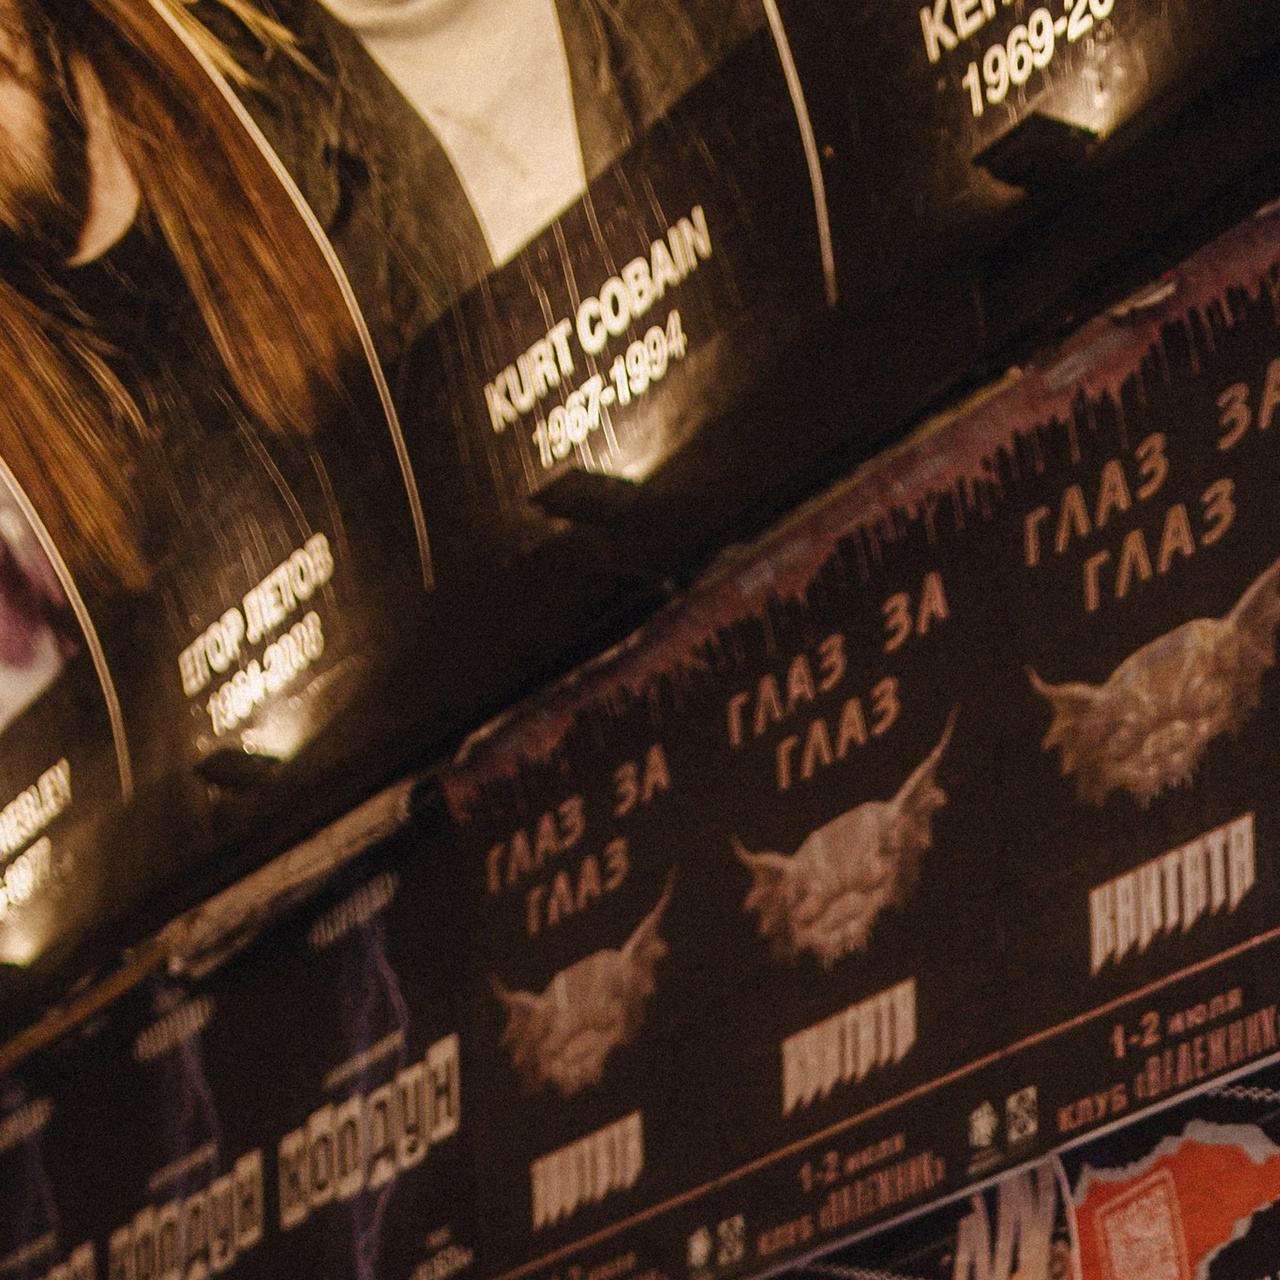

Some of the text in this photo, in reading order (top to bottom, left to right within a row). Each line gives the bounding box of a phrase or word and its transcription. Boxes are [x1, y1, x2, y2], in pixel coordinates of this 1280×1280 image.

[484, 205, 713, 435] KURT COBAIN
[532, 309, 688, 469] 1967-1994
[1025, 432, 1170, 567] ГЛАЗ
[1083, 477, 1237, 613] ГЛАЗ
[726, 572, 950, 749] ГЛАЗ ЗА
[775, 676, 900, 792] ГЛАЗ
[487, 743, 670, 894] ГЛАЗ ЗА
[526, 838, 630, 936] ГЛАЗ
[1111, 1010, 1161, 1059] 1-2
